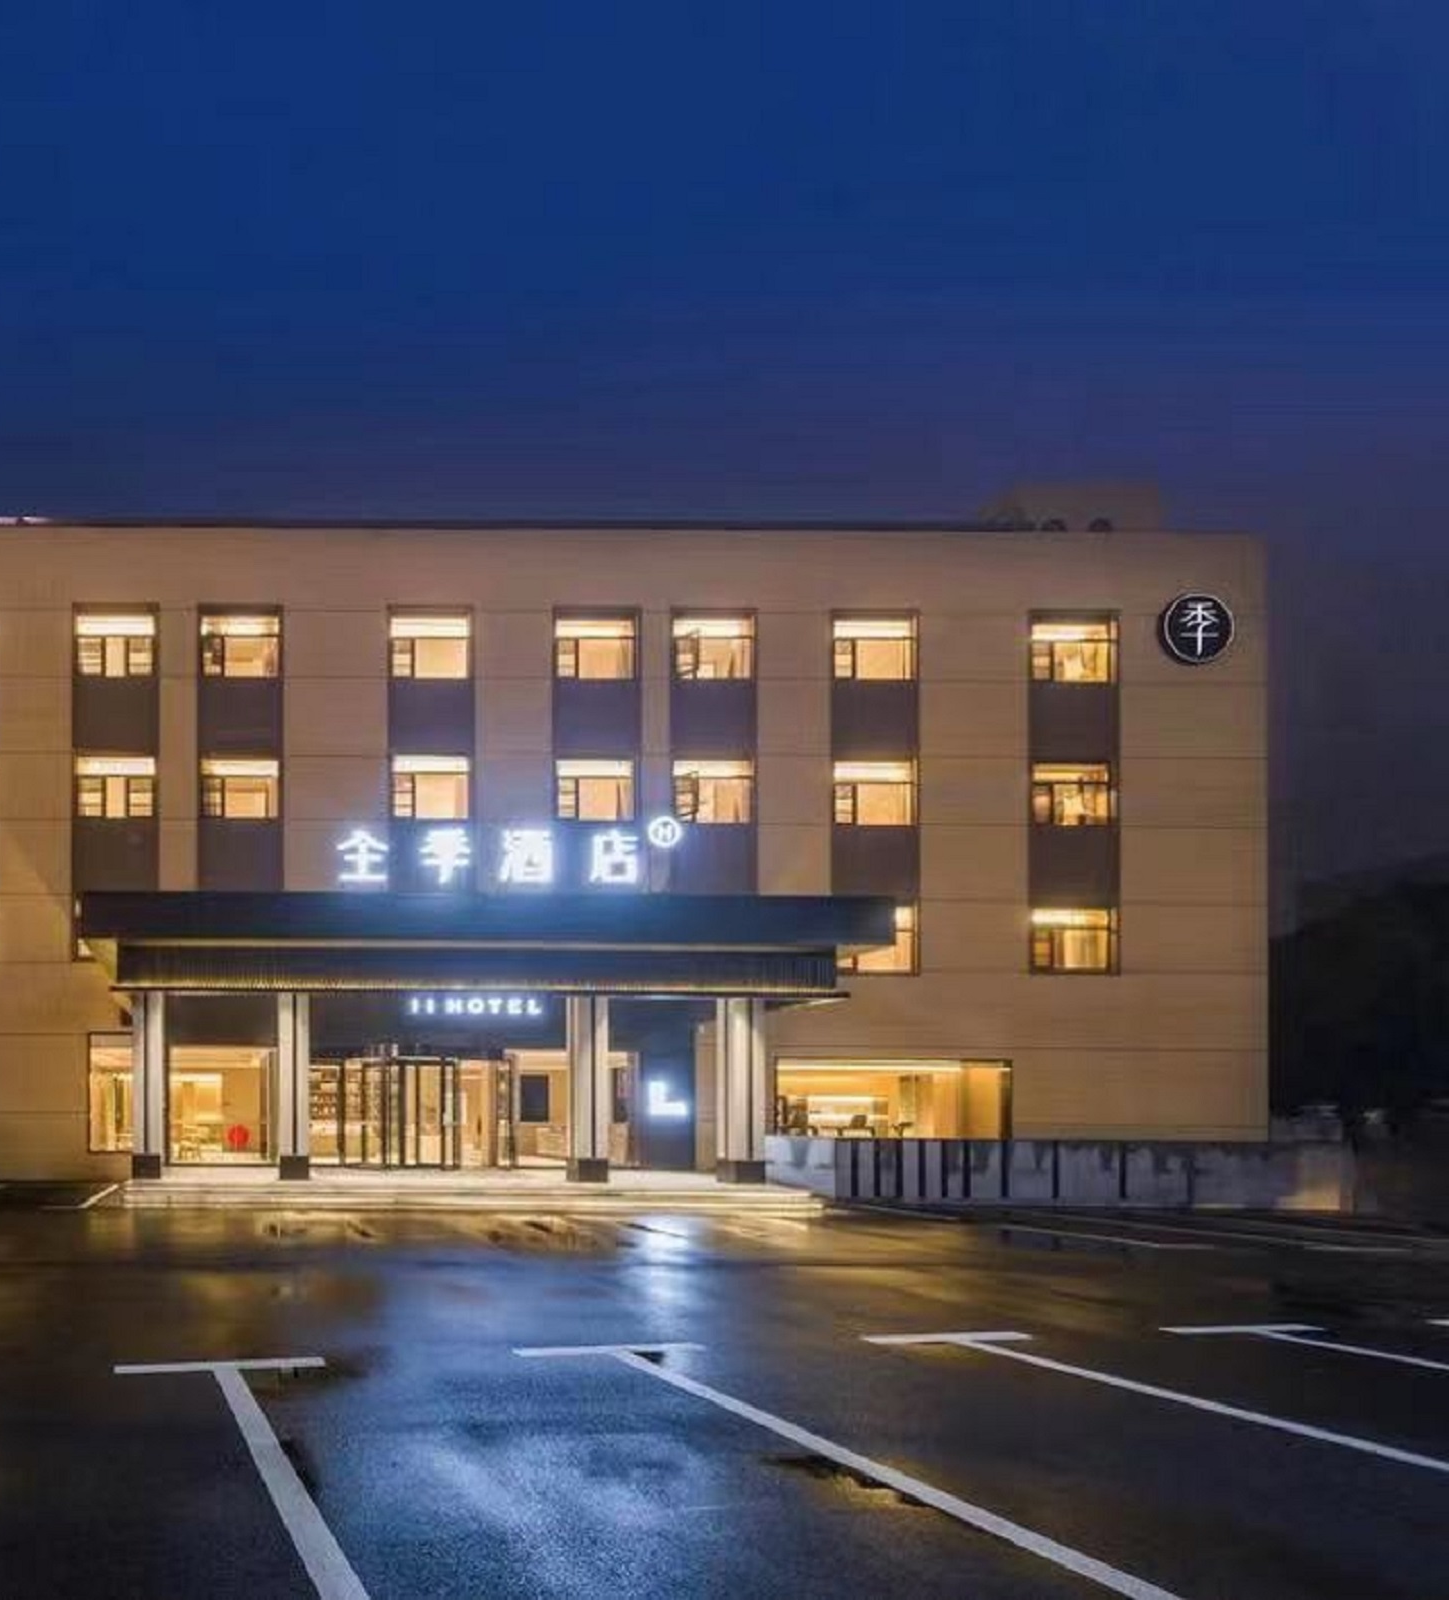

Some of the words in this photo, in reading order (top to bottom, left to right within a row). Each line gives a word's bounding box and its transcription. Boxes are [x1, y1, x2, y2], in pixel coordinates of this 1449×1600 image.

[1178, 601, 1219, 656] 季
[336, 829, 639, 884] 全季酒店
[445, 997, 542, 1015] HOTEL
